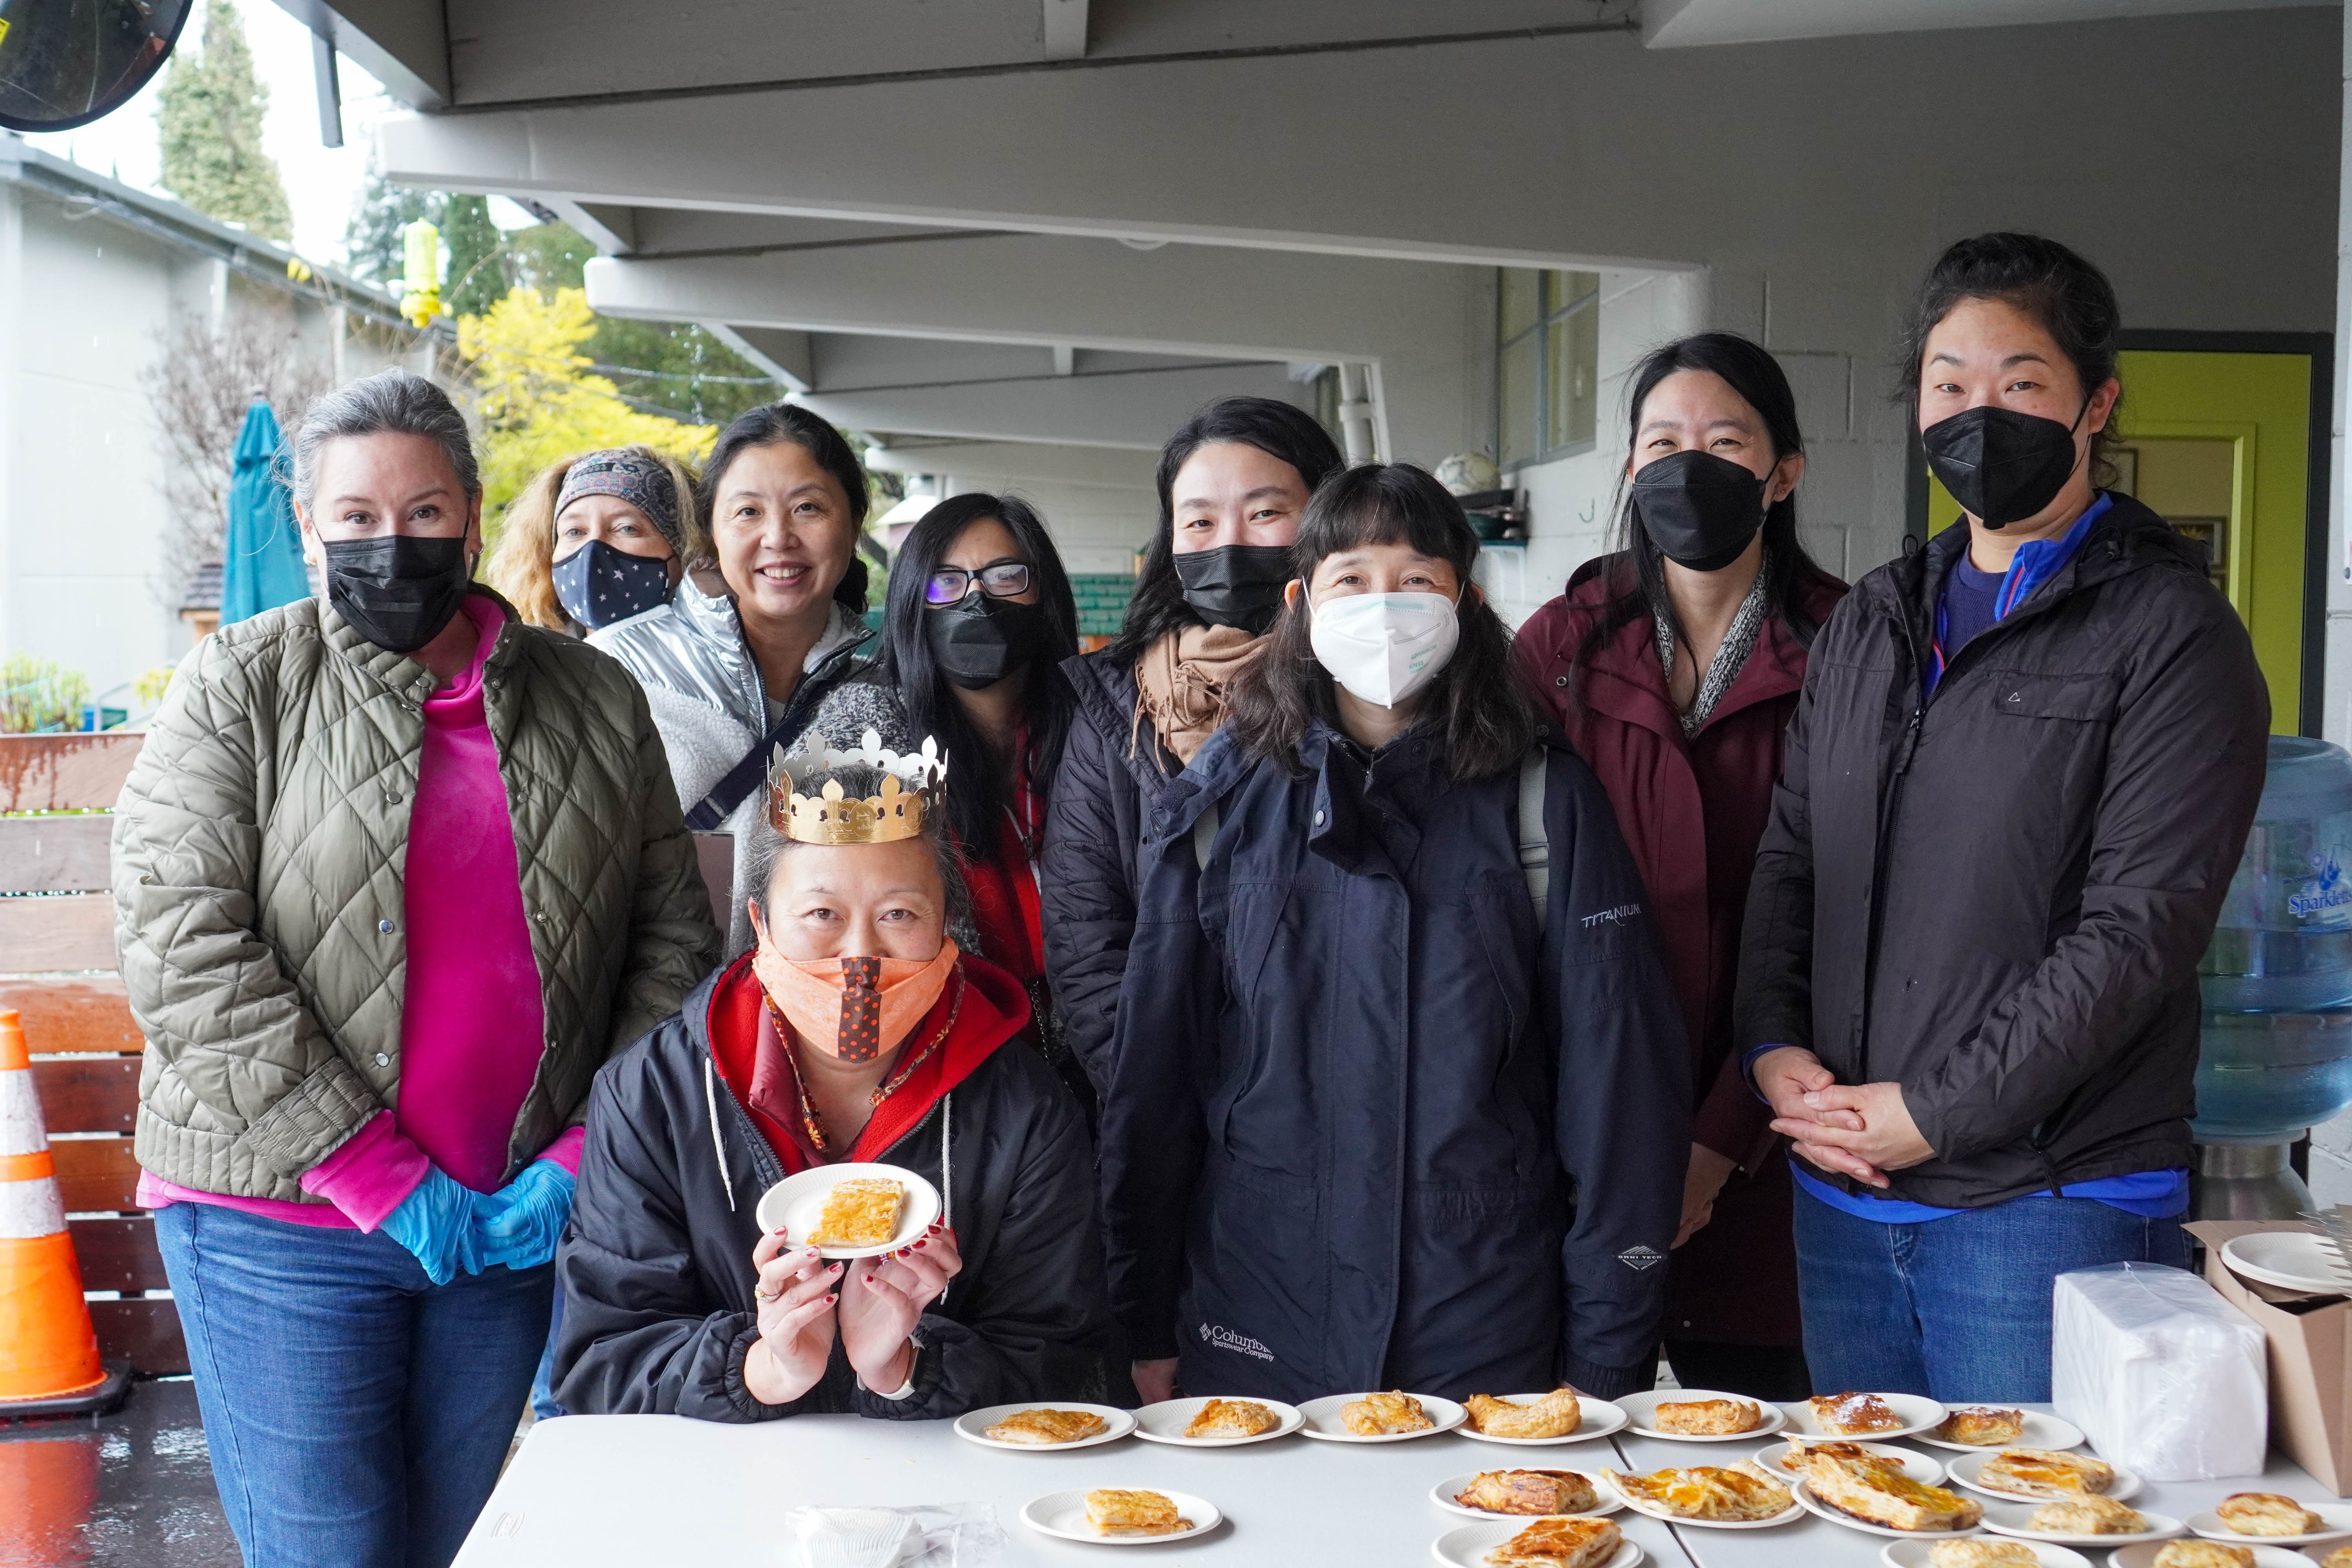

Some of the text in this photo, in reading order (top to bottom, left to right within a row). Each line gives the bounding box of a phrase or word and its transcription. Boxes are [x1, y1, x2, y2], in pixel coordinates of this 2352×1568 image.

[1409, 660, 1424, 669] KN95
[1581, 903, 1642, 928] TITANIUM
[1212, 1338, 1274, 1362] Sportswear Company
